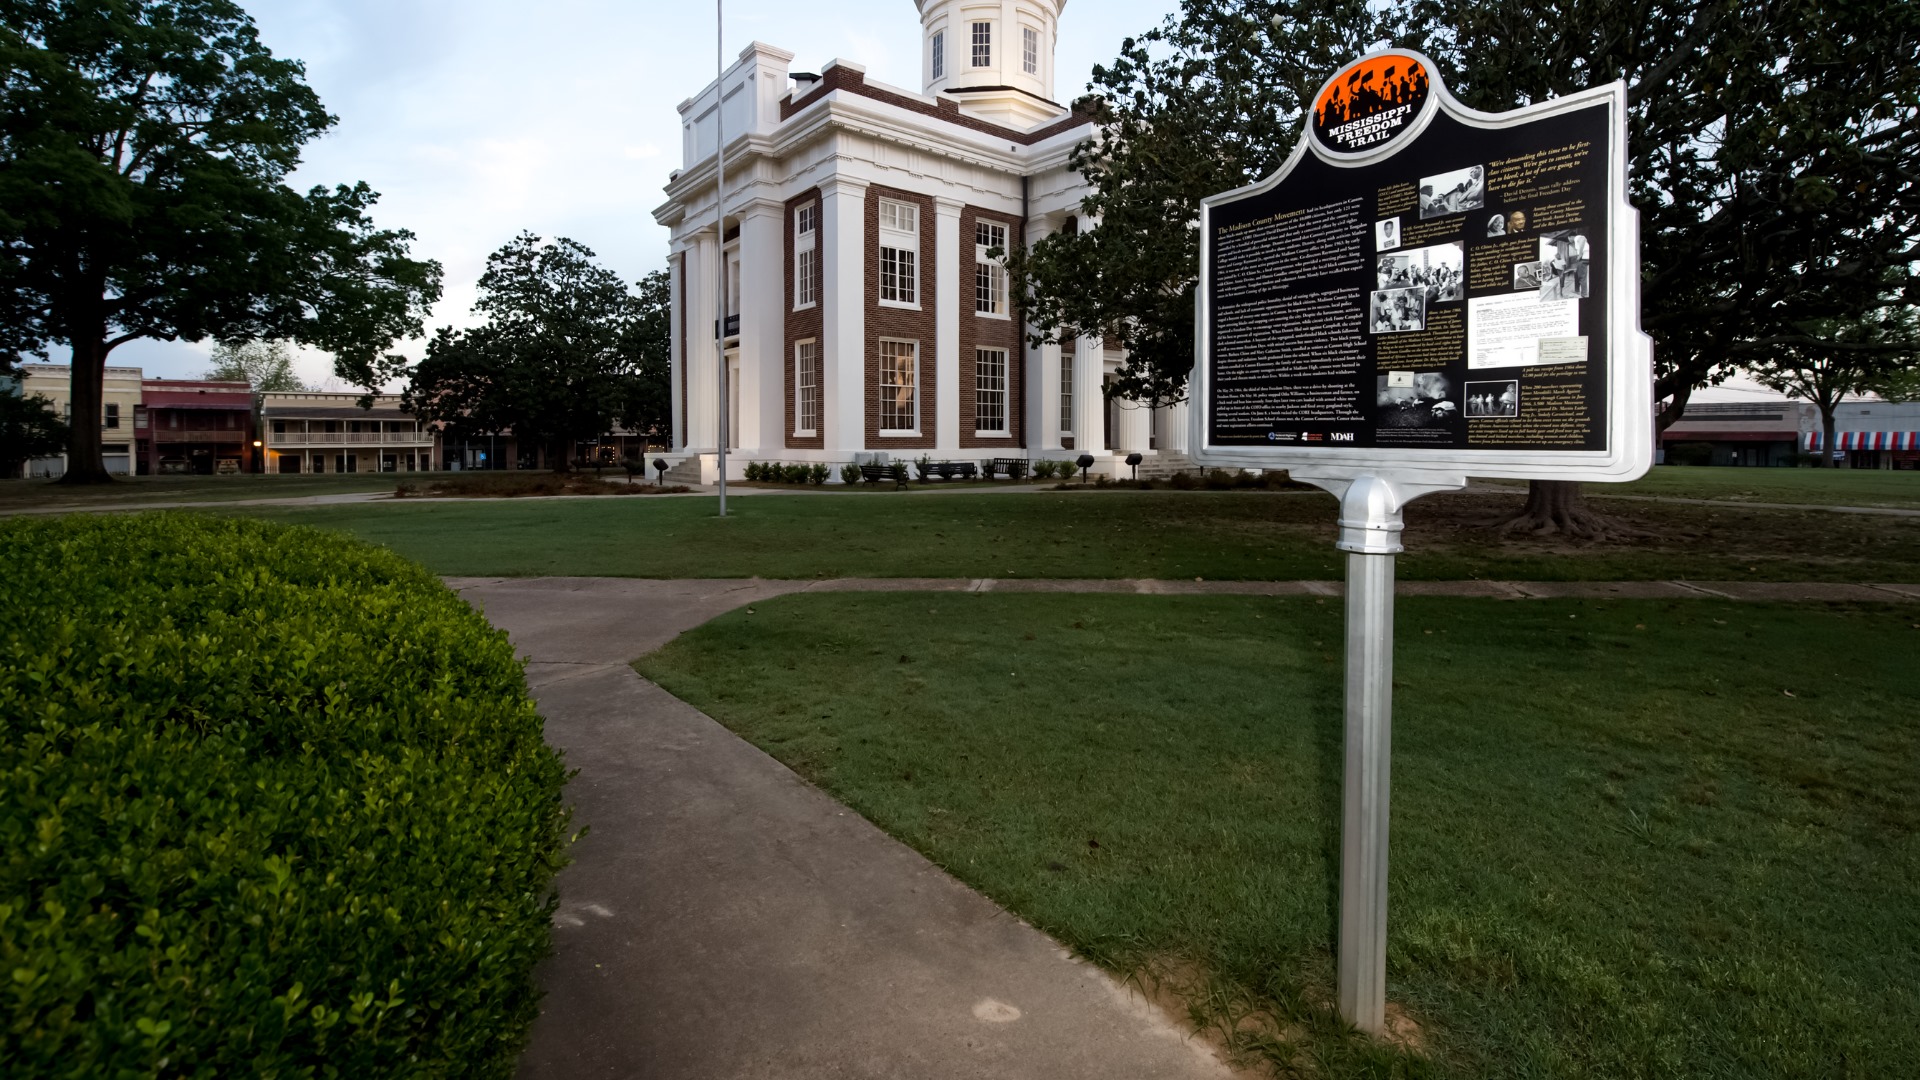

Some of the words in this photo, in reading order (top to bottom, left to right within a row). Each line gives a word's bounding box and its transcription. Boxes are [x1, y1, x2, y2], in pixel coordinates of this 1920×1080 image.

[1328, 104, 1412, 137] MISSISSIPPI
[1336, 116, 1403, 143] FREEDOM
[1348, 130, 1390, 148] TRAIL
[1506, 154, 1535, 164] demanding
[1539, 158, 1548, 166] got
[1488, 177, 1496, 185] got
[1557, 161, 1573, 171] going
[1504, 190, 1518, 198] David
[1218, 227, 1228, 235] The
[1229, 222, 1251, 232] Madison
[1252, 215, 1272, 227] County
[1274, 209, 1305, 221] Movement
[1330, 432, 1354, 441] MDAH
